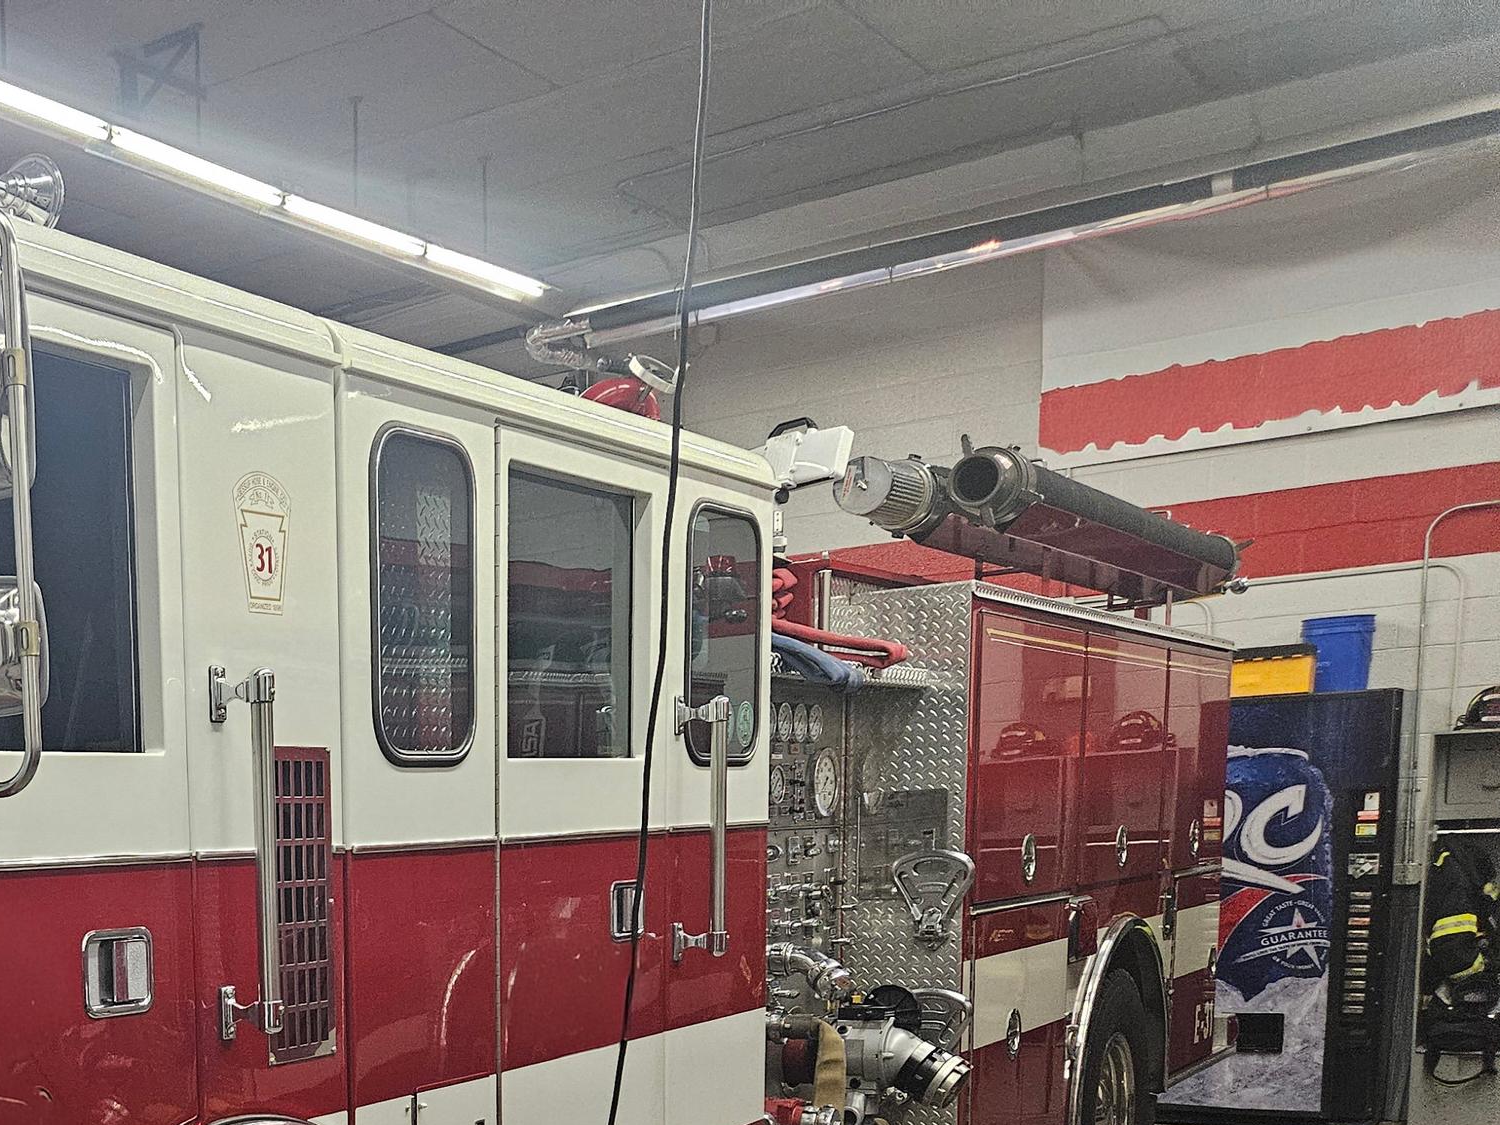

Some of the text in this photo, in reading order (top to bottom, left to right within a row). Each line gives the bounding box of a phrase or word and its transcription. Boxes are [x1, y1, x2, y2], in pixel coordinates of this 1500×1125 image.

[255, 543, 273, 575] 31
[1275, 901, 1293, 911] TASTE
[1260, 929, 1328, 945] GUARANTEE
[1194, 1000, 1214, 1044] E-31
